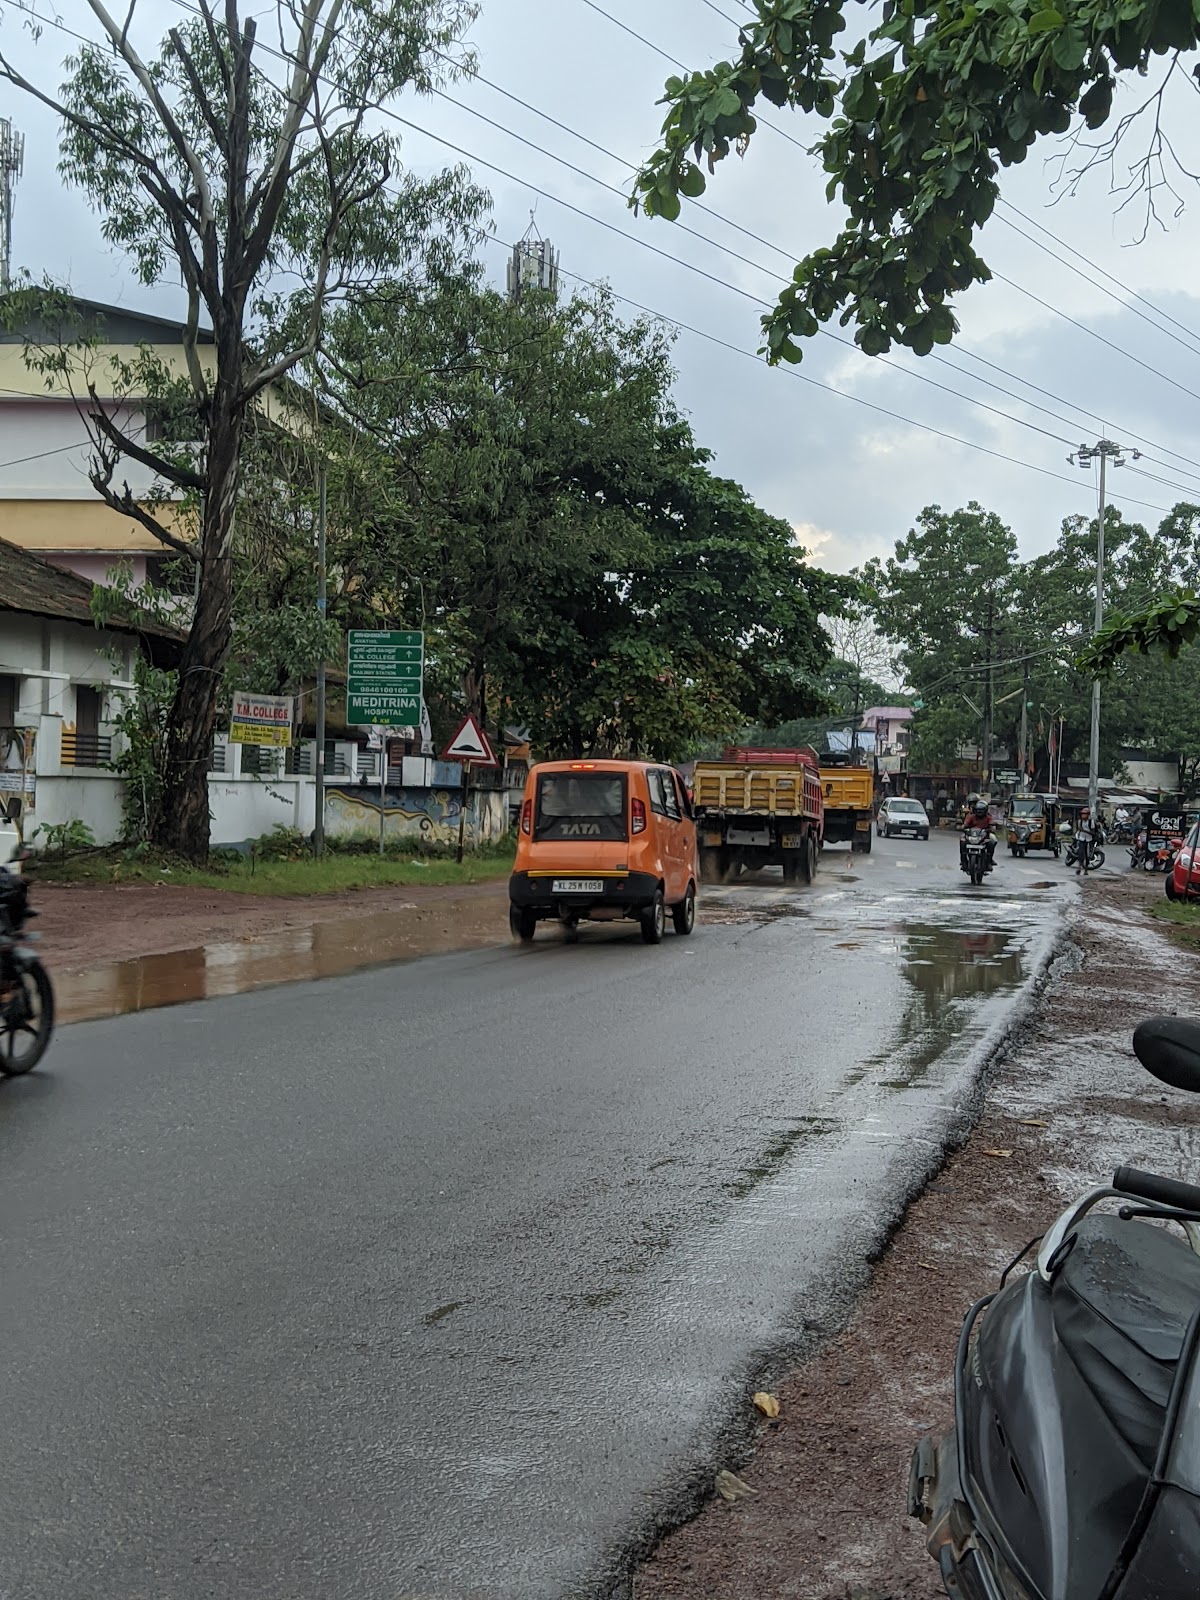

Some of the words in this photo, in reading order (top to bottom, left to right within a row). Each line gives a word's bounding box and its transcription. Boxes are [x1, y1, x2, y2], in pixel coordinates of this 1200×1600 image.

[352, 697, 418, 709] MEDITRINA
[236, 703, 252, 716] T.M.
[253, 706, 289, 720] COLLEGE
[560, 823, 601, 835] TATA
[558, 882, 567, 890] KL
[568, 882, 577, 890] 25
